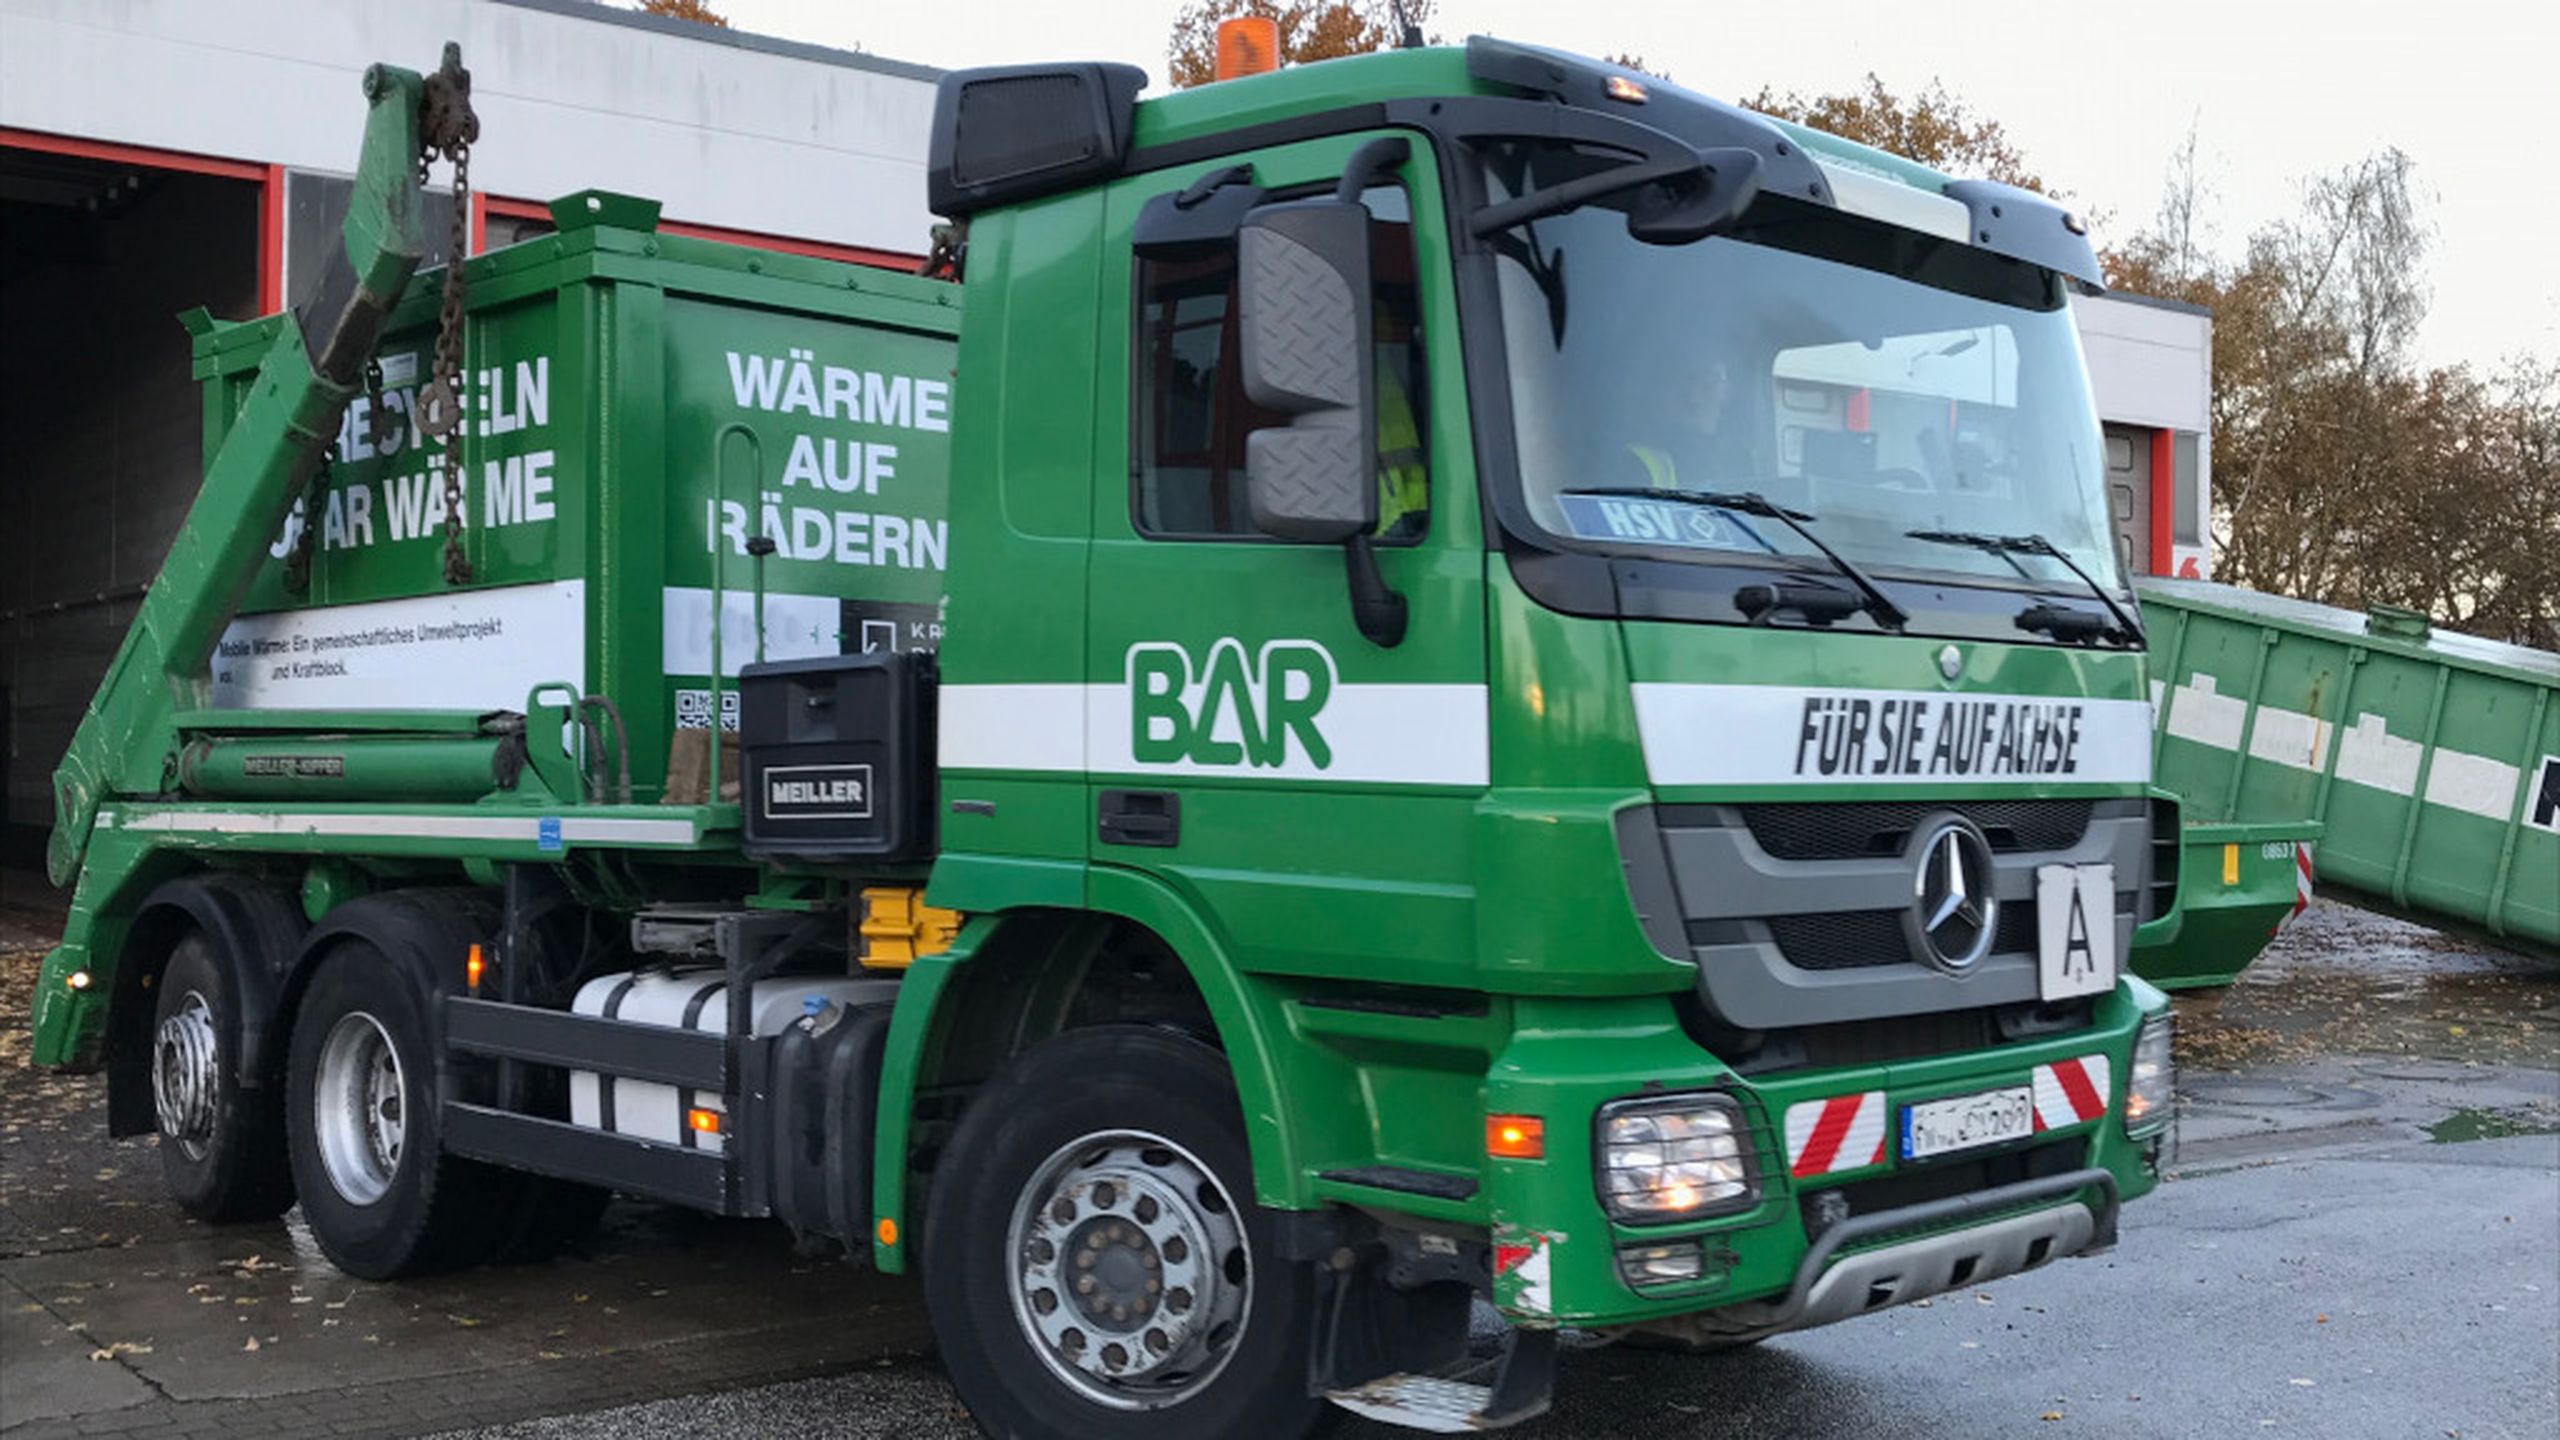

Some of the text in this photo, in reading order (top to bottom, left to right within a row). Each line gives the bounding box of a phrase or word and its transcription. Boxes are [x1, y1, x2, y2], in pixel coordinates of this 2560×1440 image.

[727, 348, 949, 433] WÄRME
[781, 434, 898, 495] AUF
[707, 491, 949, 571] RÄDERN
[1600, 502, 1678, 540] HSV
[1131, 642, 1333, 770] BAR
[1794, 698, 2083, 776] FÜR SIE AUF ACHSE
[771, 780, 863, 804] MEILLER
[2063, 883, 2094, 976] A
